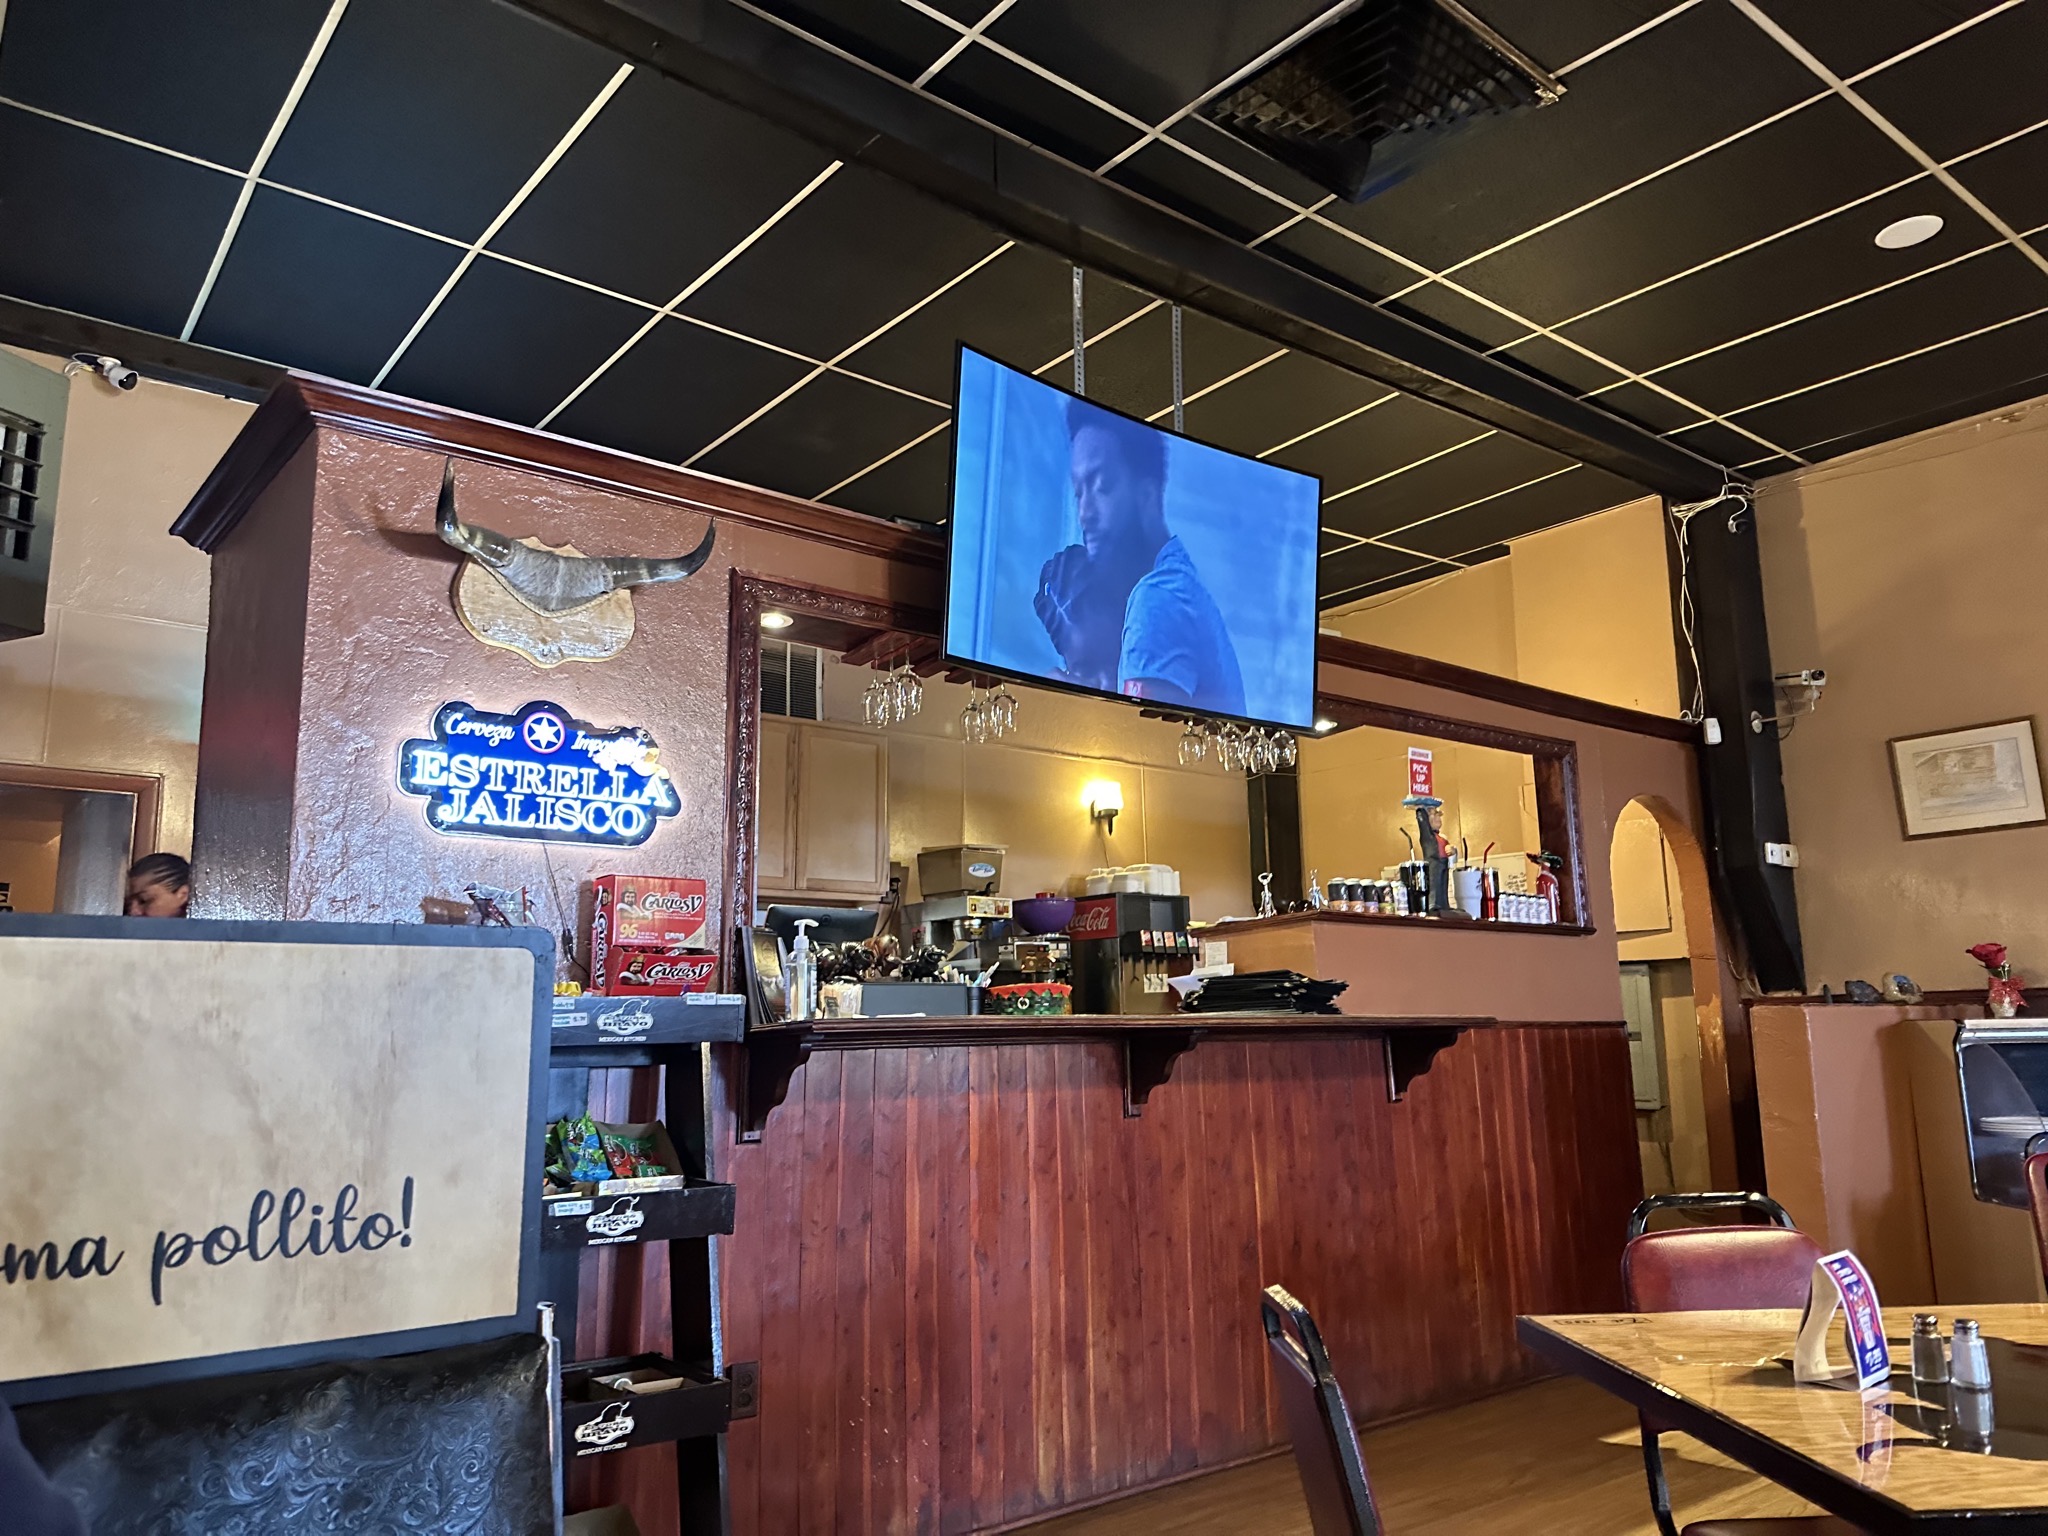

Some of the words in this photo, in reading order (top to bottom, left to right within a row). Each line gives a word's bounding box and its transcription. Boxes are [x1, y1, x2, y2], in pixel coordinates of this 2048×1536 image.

[445, 712, 516, 747] Cerveza
[1412, 763, 1428, 774] PICK
[410, 749, 673, 808] ESTRELLA
[1416, 774, 1426, 782] UP
[1413, 783, 1429, 793] HERE
[437, 788, 647, 837] JALISCO
[619, 923, 639, 939] 96
[602, 1020, 649, 1028] BRAVO
[592, 1220, 638, 1229] BRAVO
[581, 1426, 628, 1438] BRAVO
